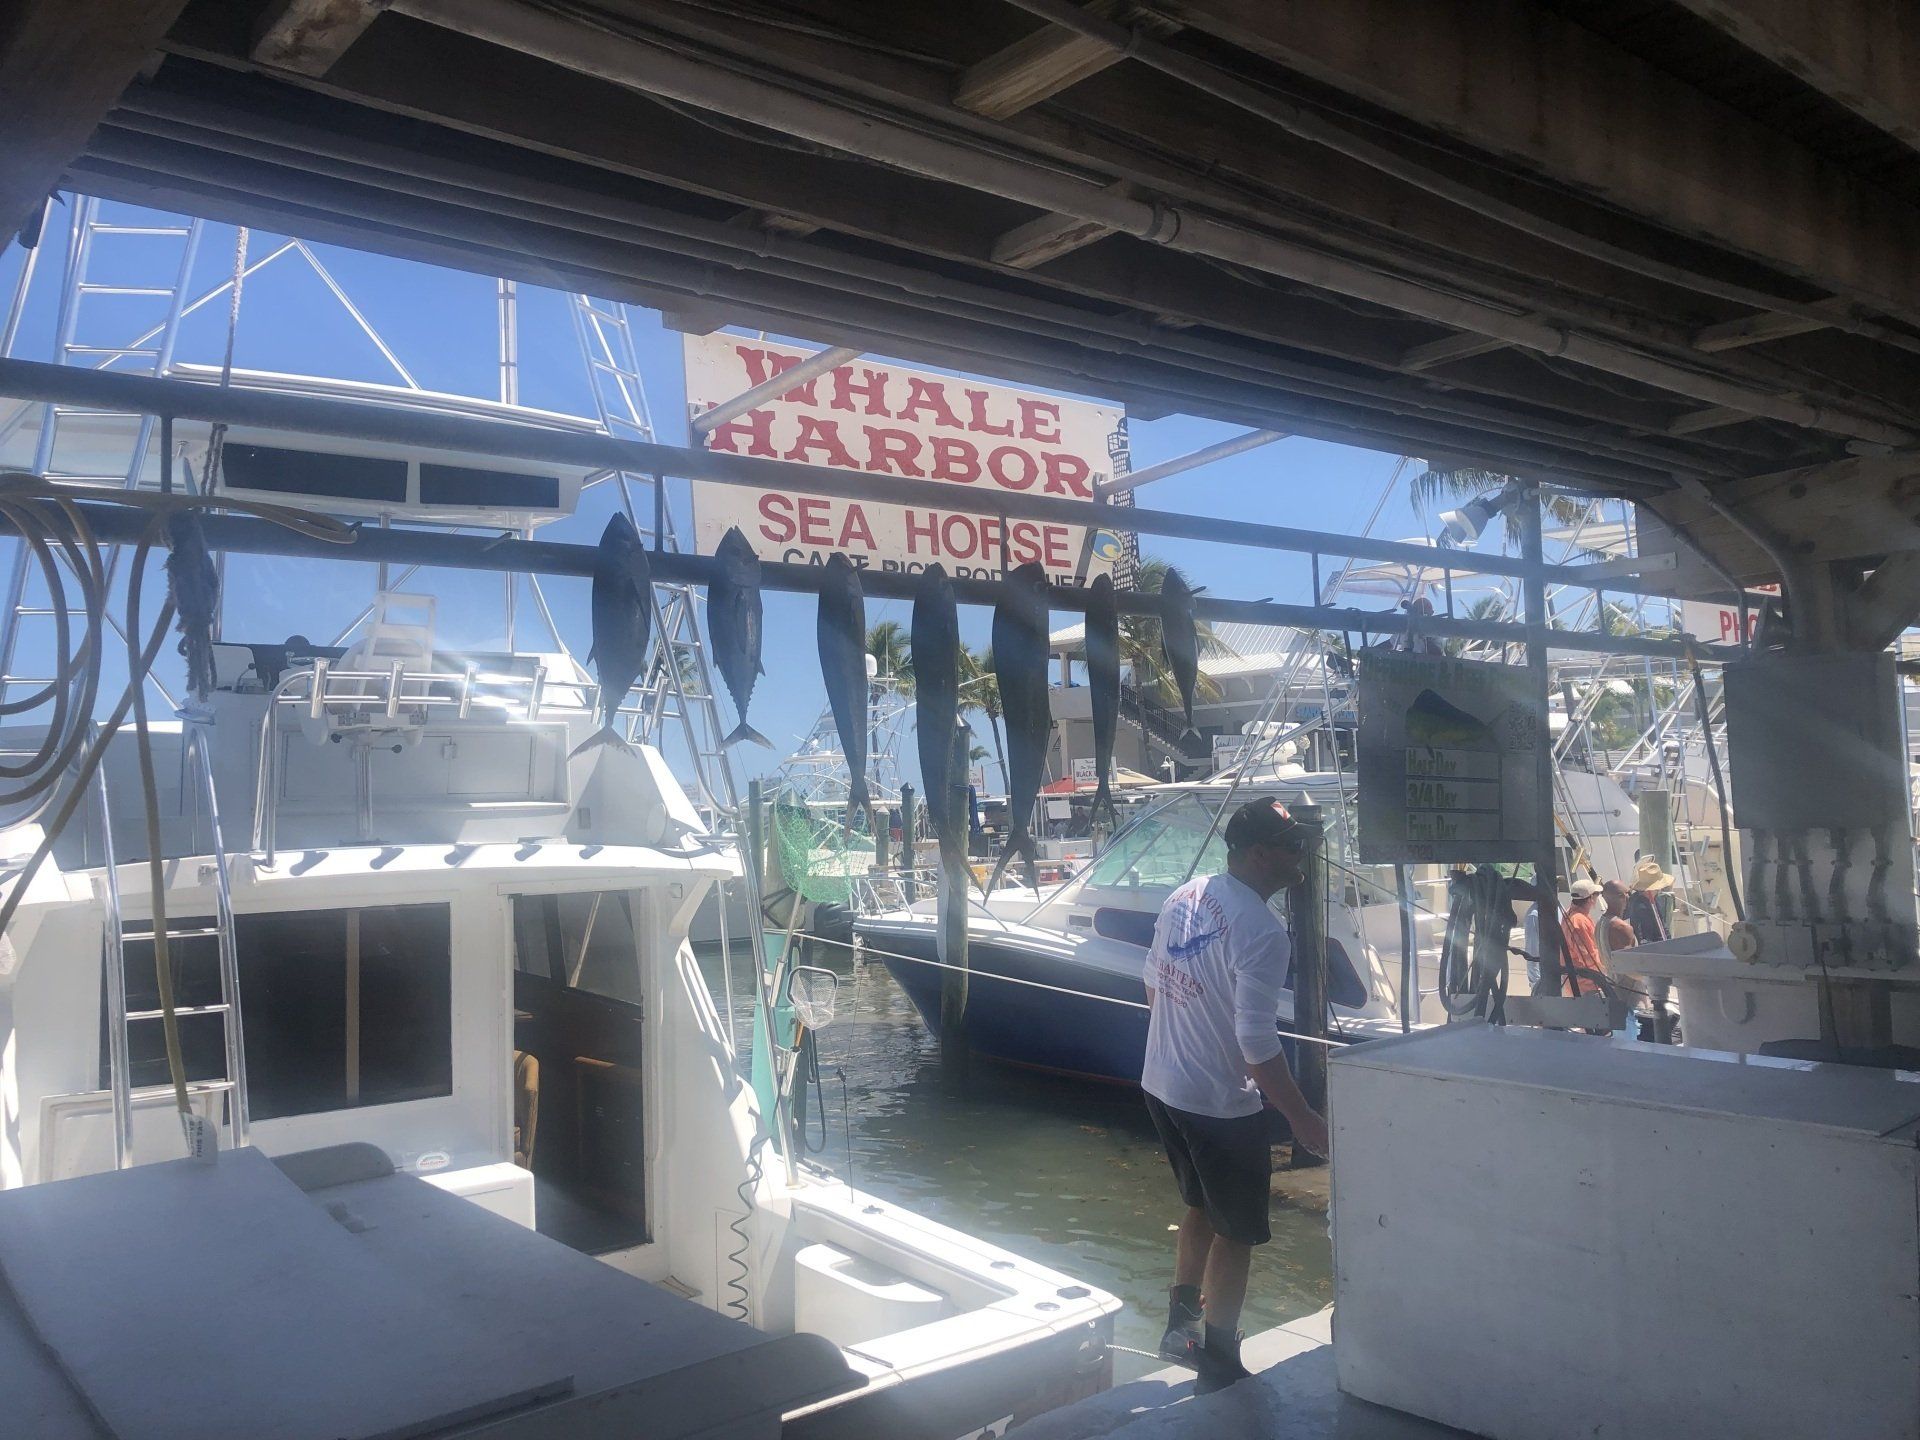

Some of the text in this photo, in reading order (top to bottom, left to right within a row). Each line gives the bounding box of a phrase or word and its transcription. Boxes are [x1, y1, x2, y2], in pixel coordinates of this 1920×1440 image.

[736, 345, 1062, 445] WHALE
[707, 402, 1093, 498] HARBOR
[757, 493, 1072, 568] SEA HORSE
[1407, 783, 1433, 807] 3/4
